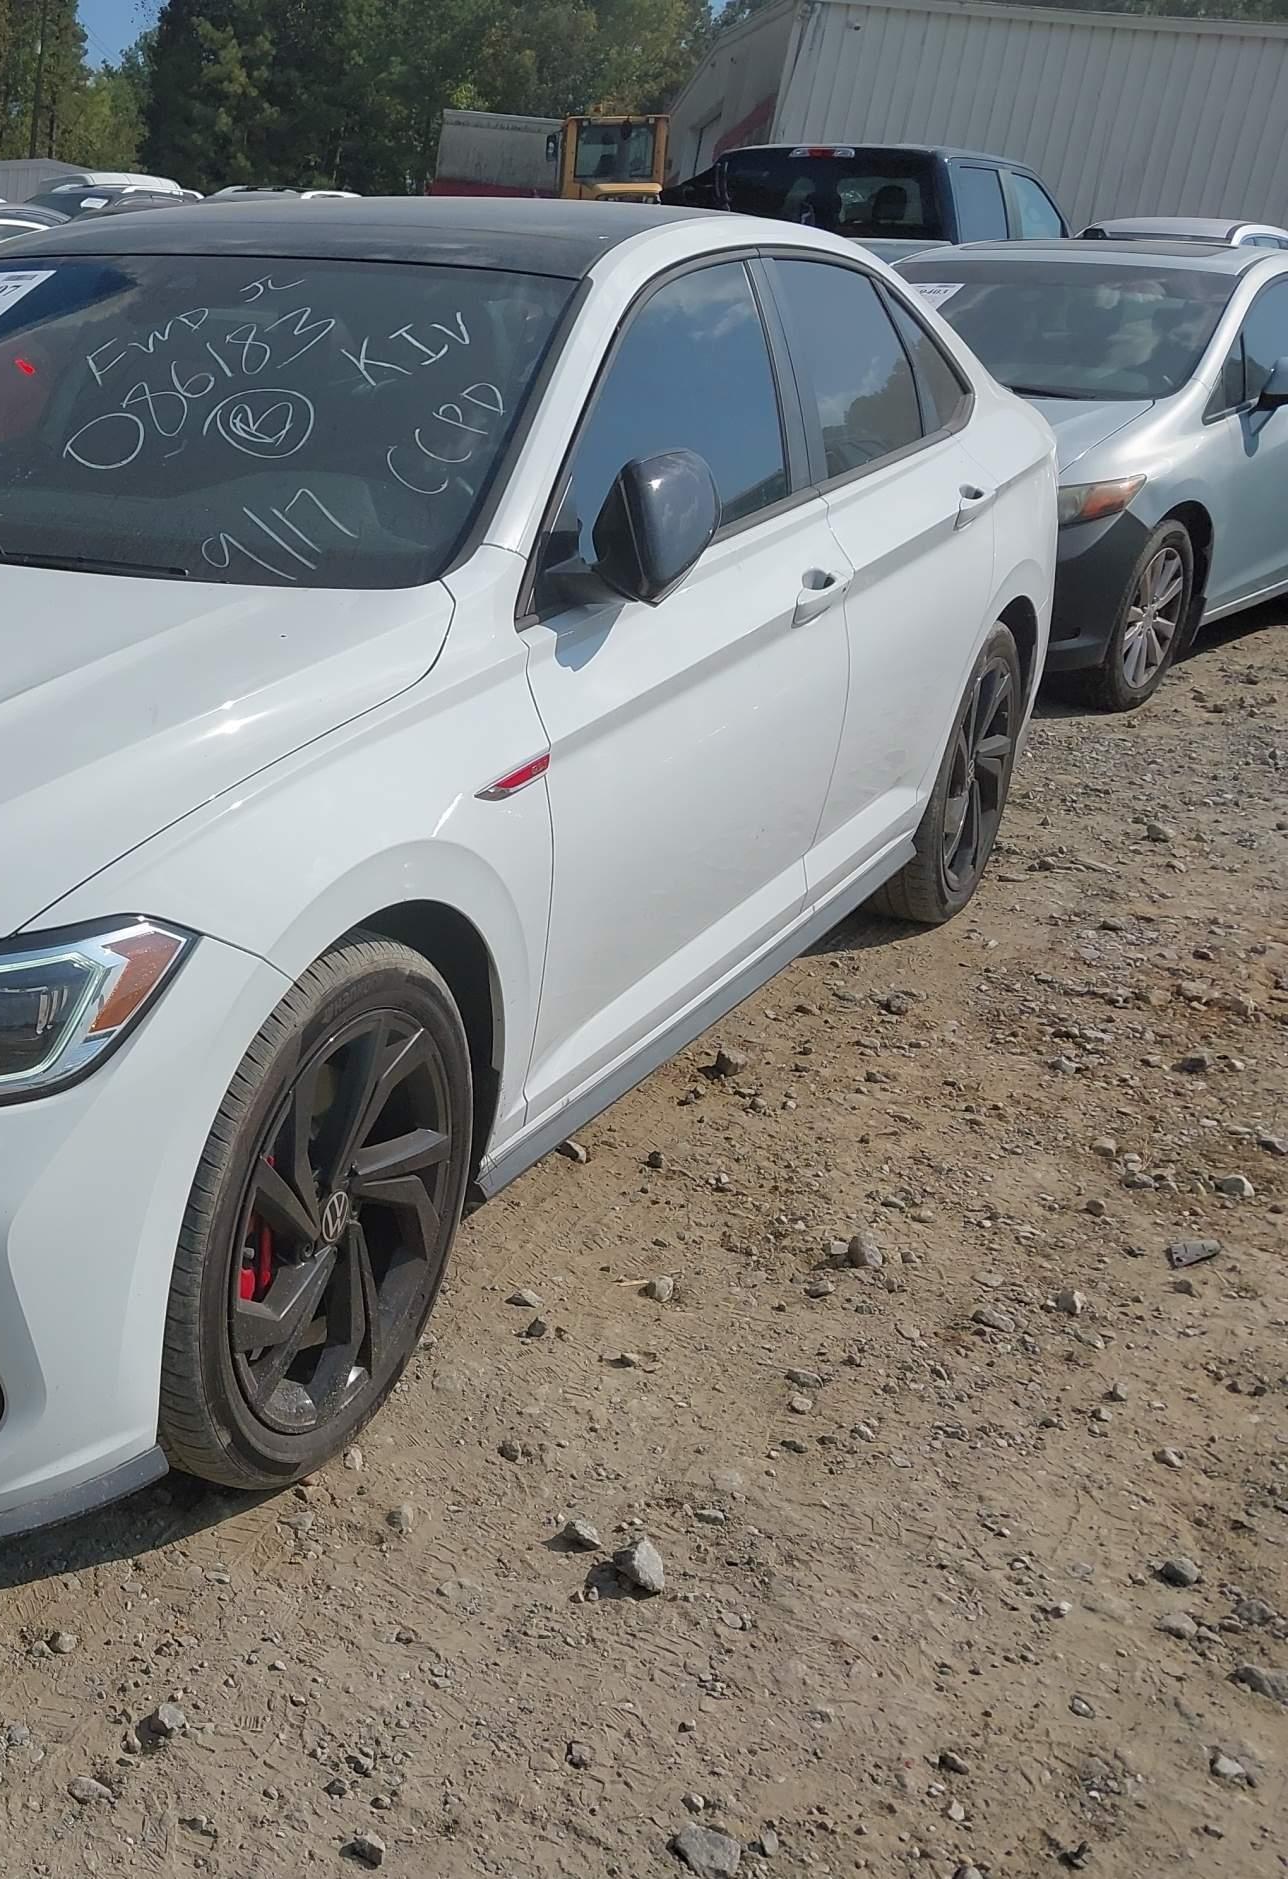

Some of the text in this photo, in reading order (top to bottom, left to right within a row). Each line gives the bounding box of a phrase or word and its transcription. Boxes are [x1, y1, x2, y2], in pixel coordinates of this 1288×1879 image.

[63, 306, 336, 469] 086183
[85, 307, 210, 386] FWD
[386, 382, 504, 494] CCPD
